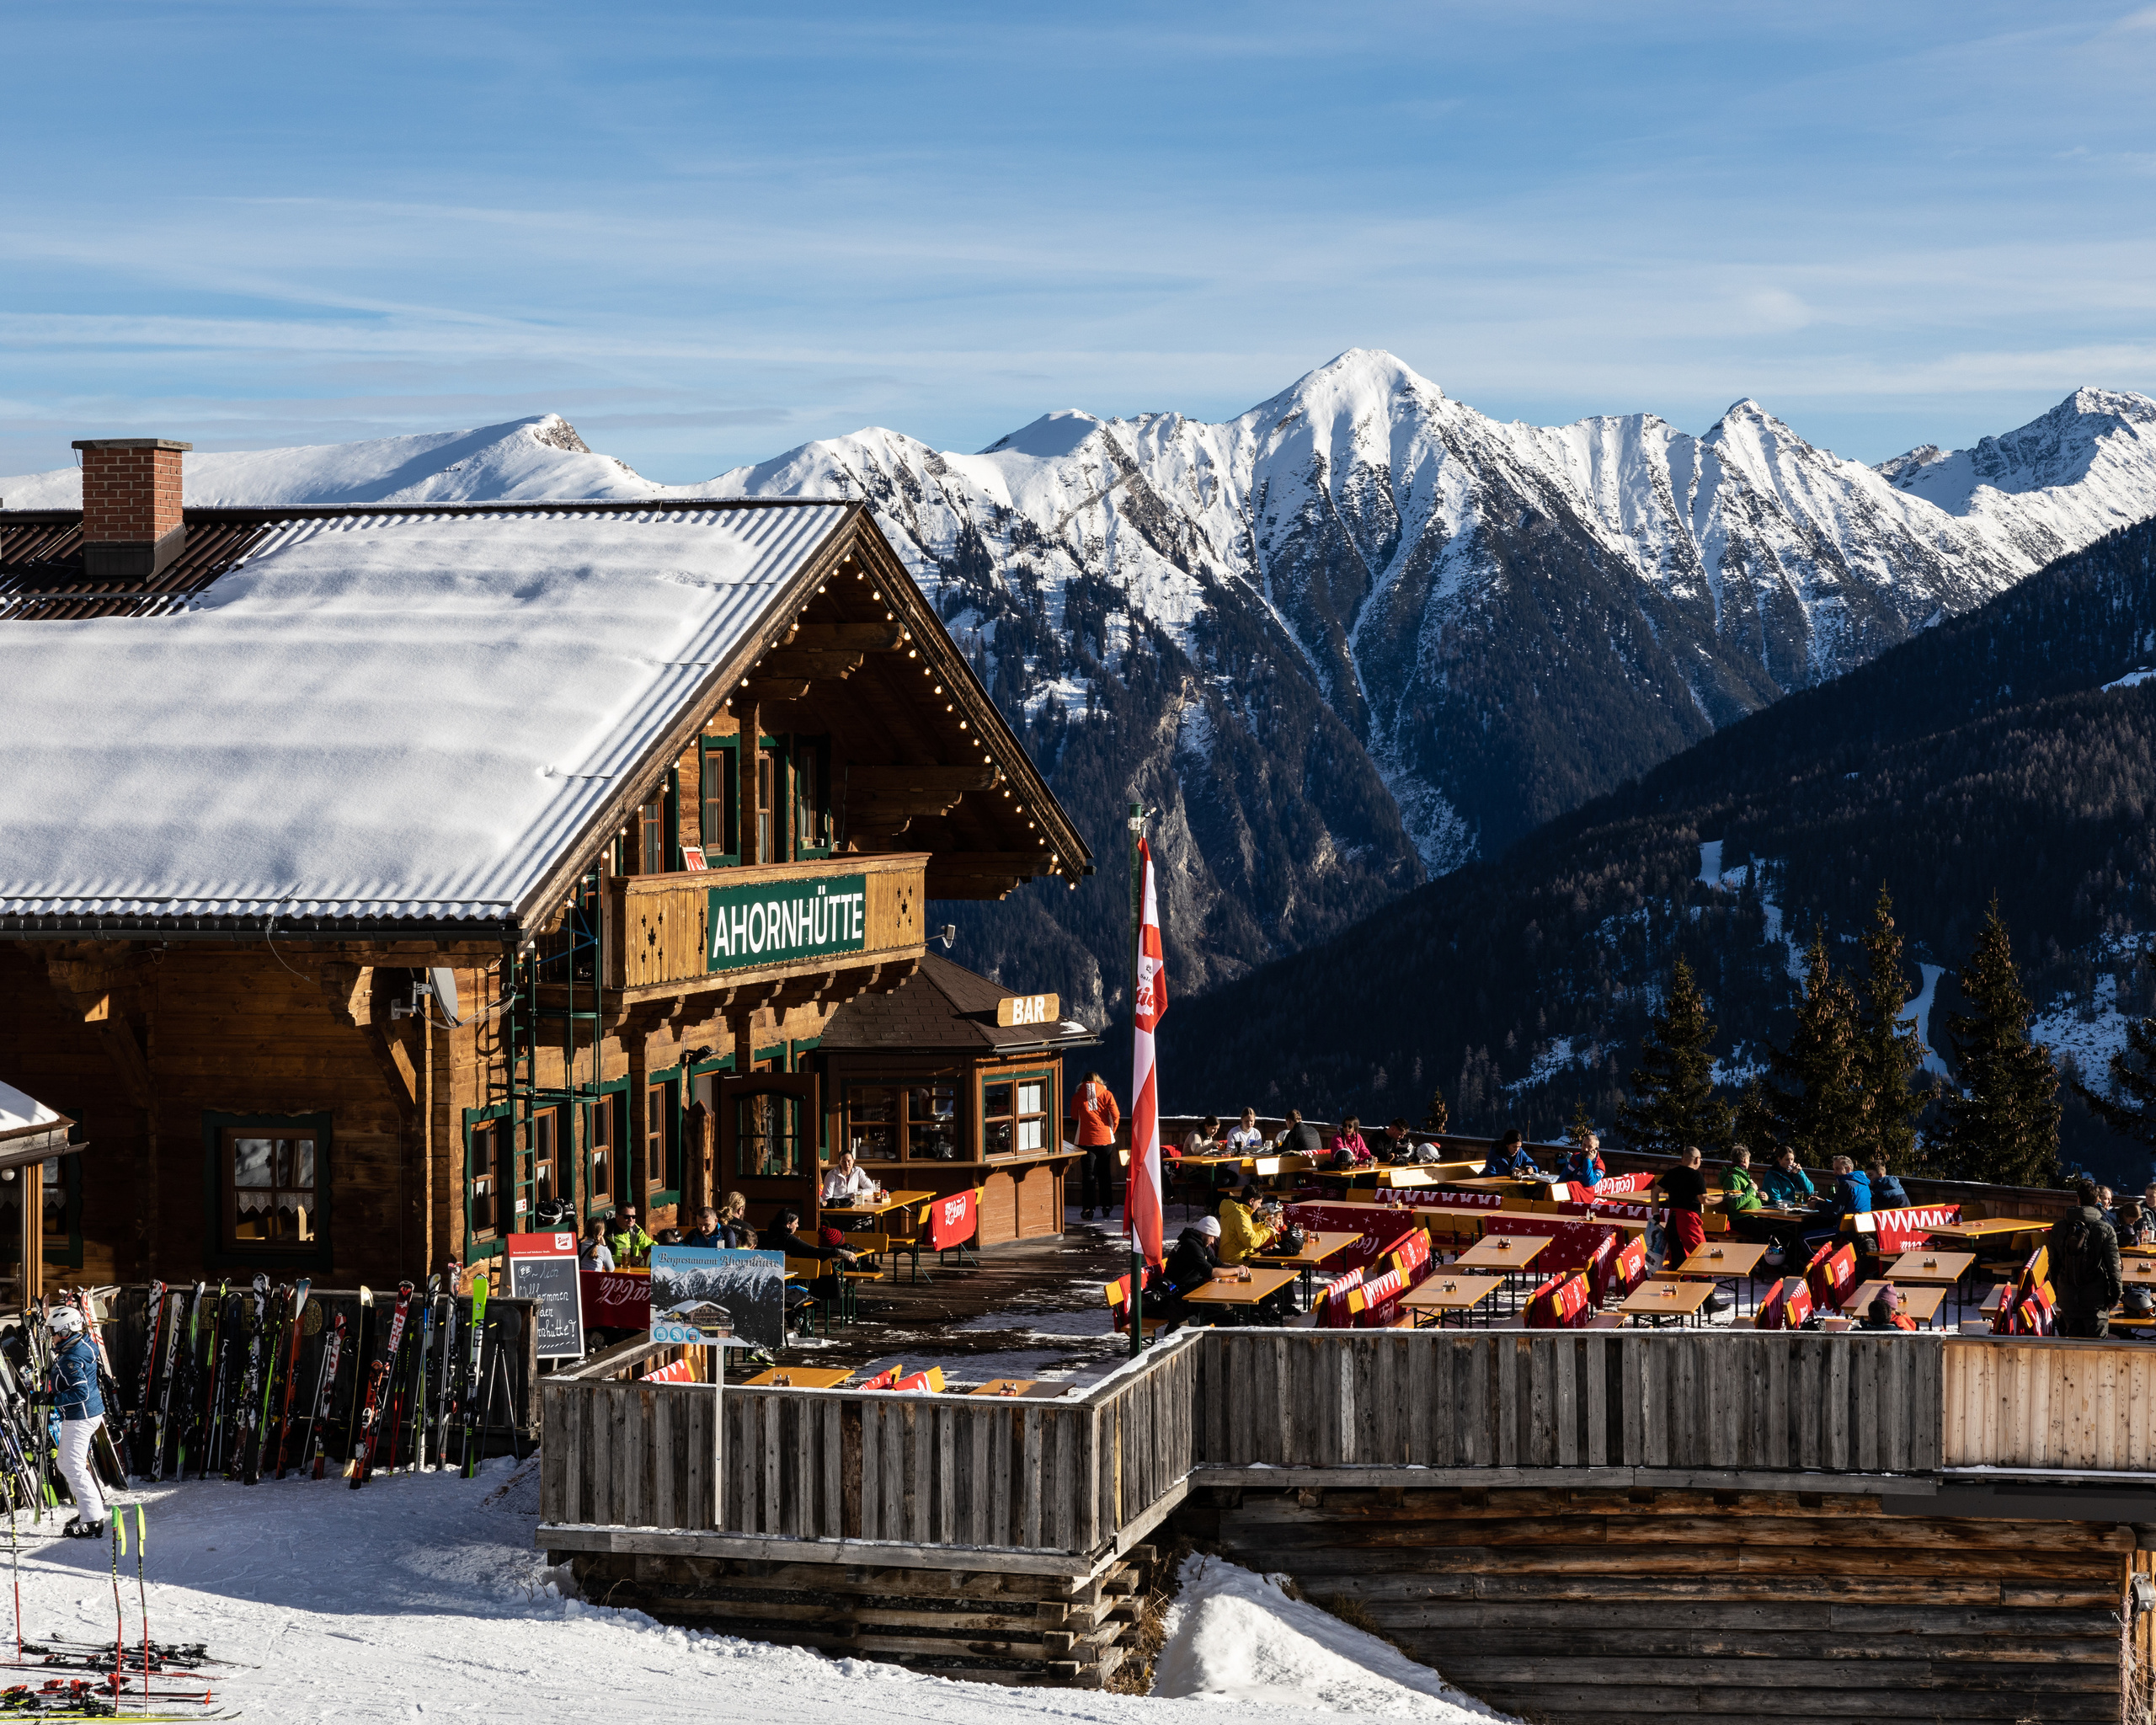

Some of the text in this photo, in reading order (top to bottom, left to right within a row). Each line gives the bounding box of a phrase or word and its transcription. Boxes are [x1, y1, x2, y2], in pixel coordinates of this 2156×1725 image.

[712, 884, 863, 959] AHORNHÜTTE
[1012, 996, 1045, 1025] BAR
[658, 1252, 718, 1267] Bergrestaurant
[387, 1312, 406, 1352] HERO
[537, 1318, 577, 1338] rnhütte!
